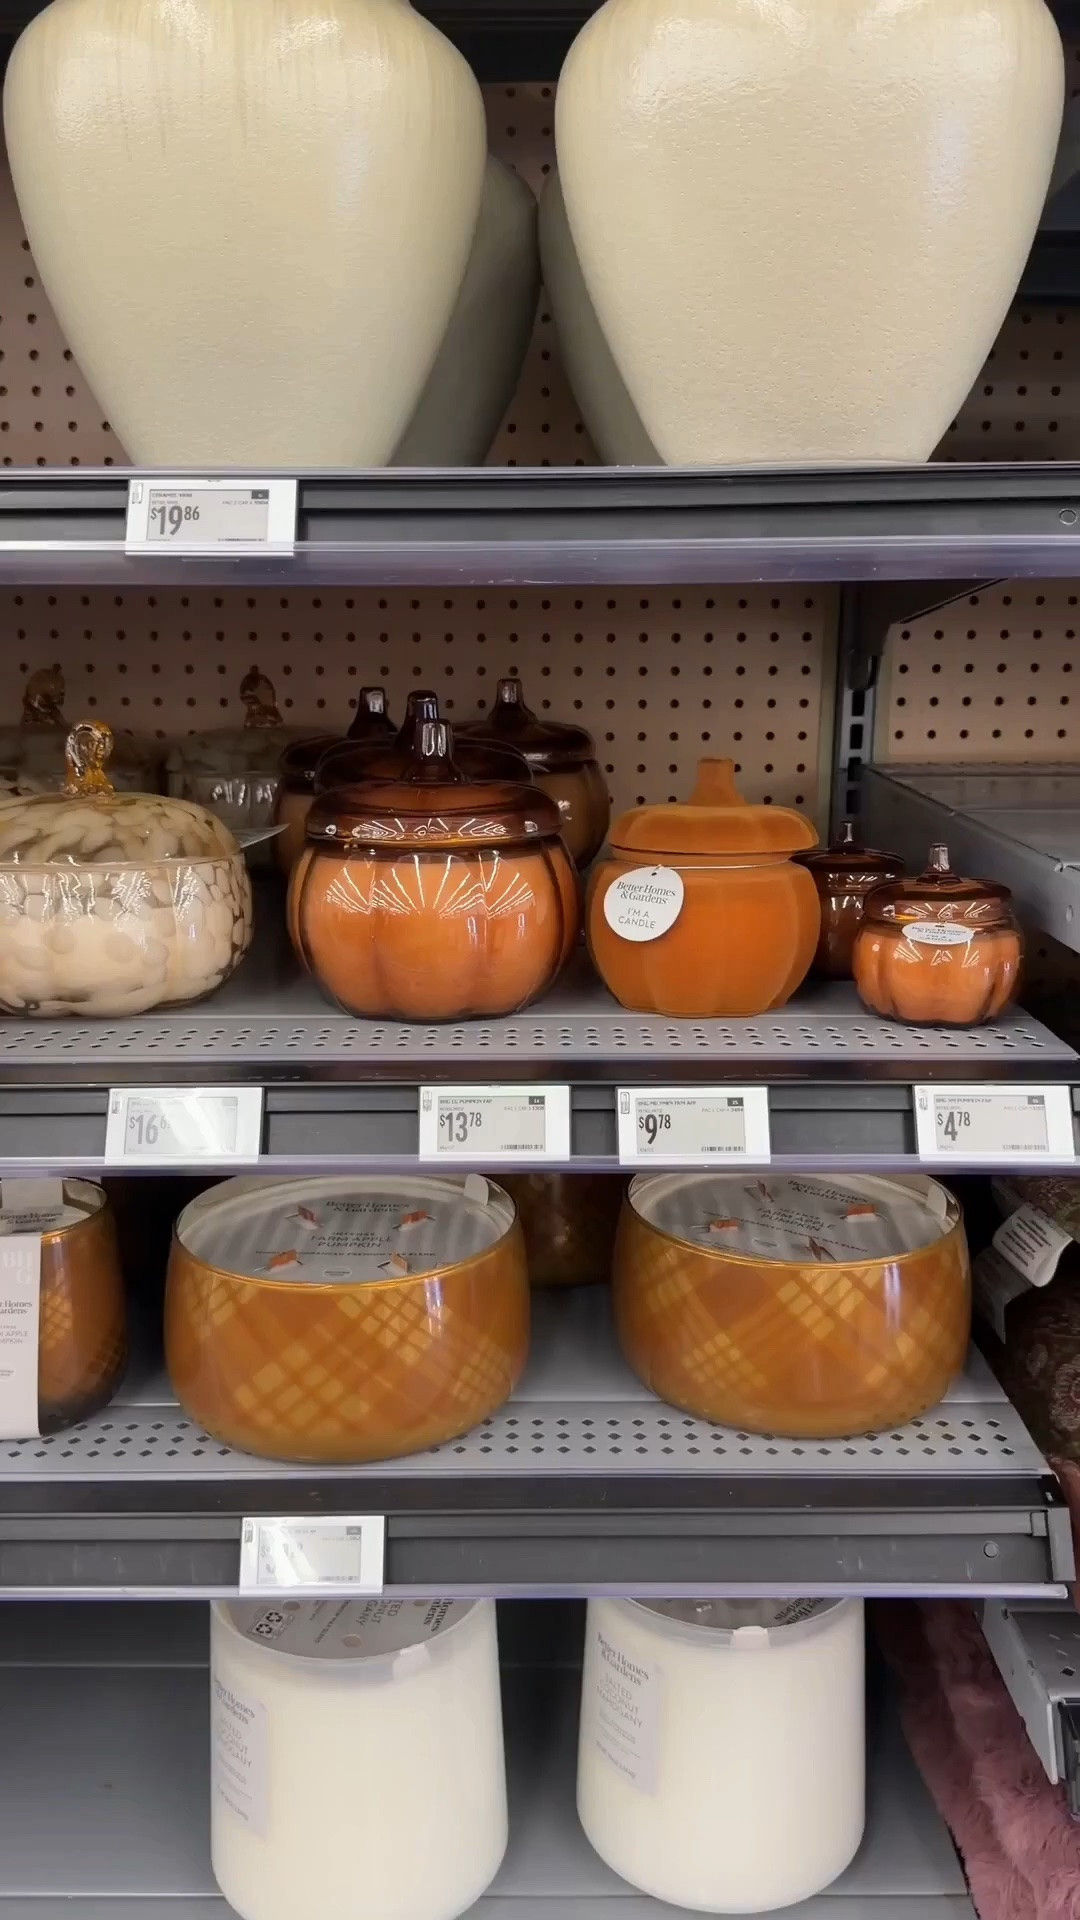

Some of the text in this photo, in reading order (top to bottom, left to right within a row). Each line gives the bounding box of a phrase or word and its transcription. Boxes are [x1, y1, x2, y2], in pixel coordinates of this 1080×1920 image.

[616, 881, 677, 897] Better Homes
[627, 907, 650, 918] I'M A
[618, 915, 657, 929] CANDLE
[4, 1300, 33, 1308] Homes
[617, 1651, 649, 1680] Homes
